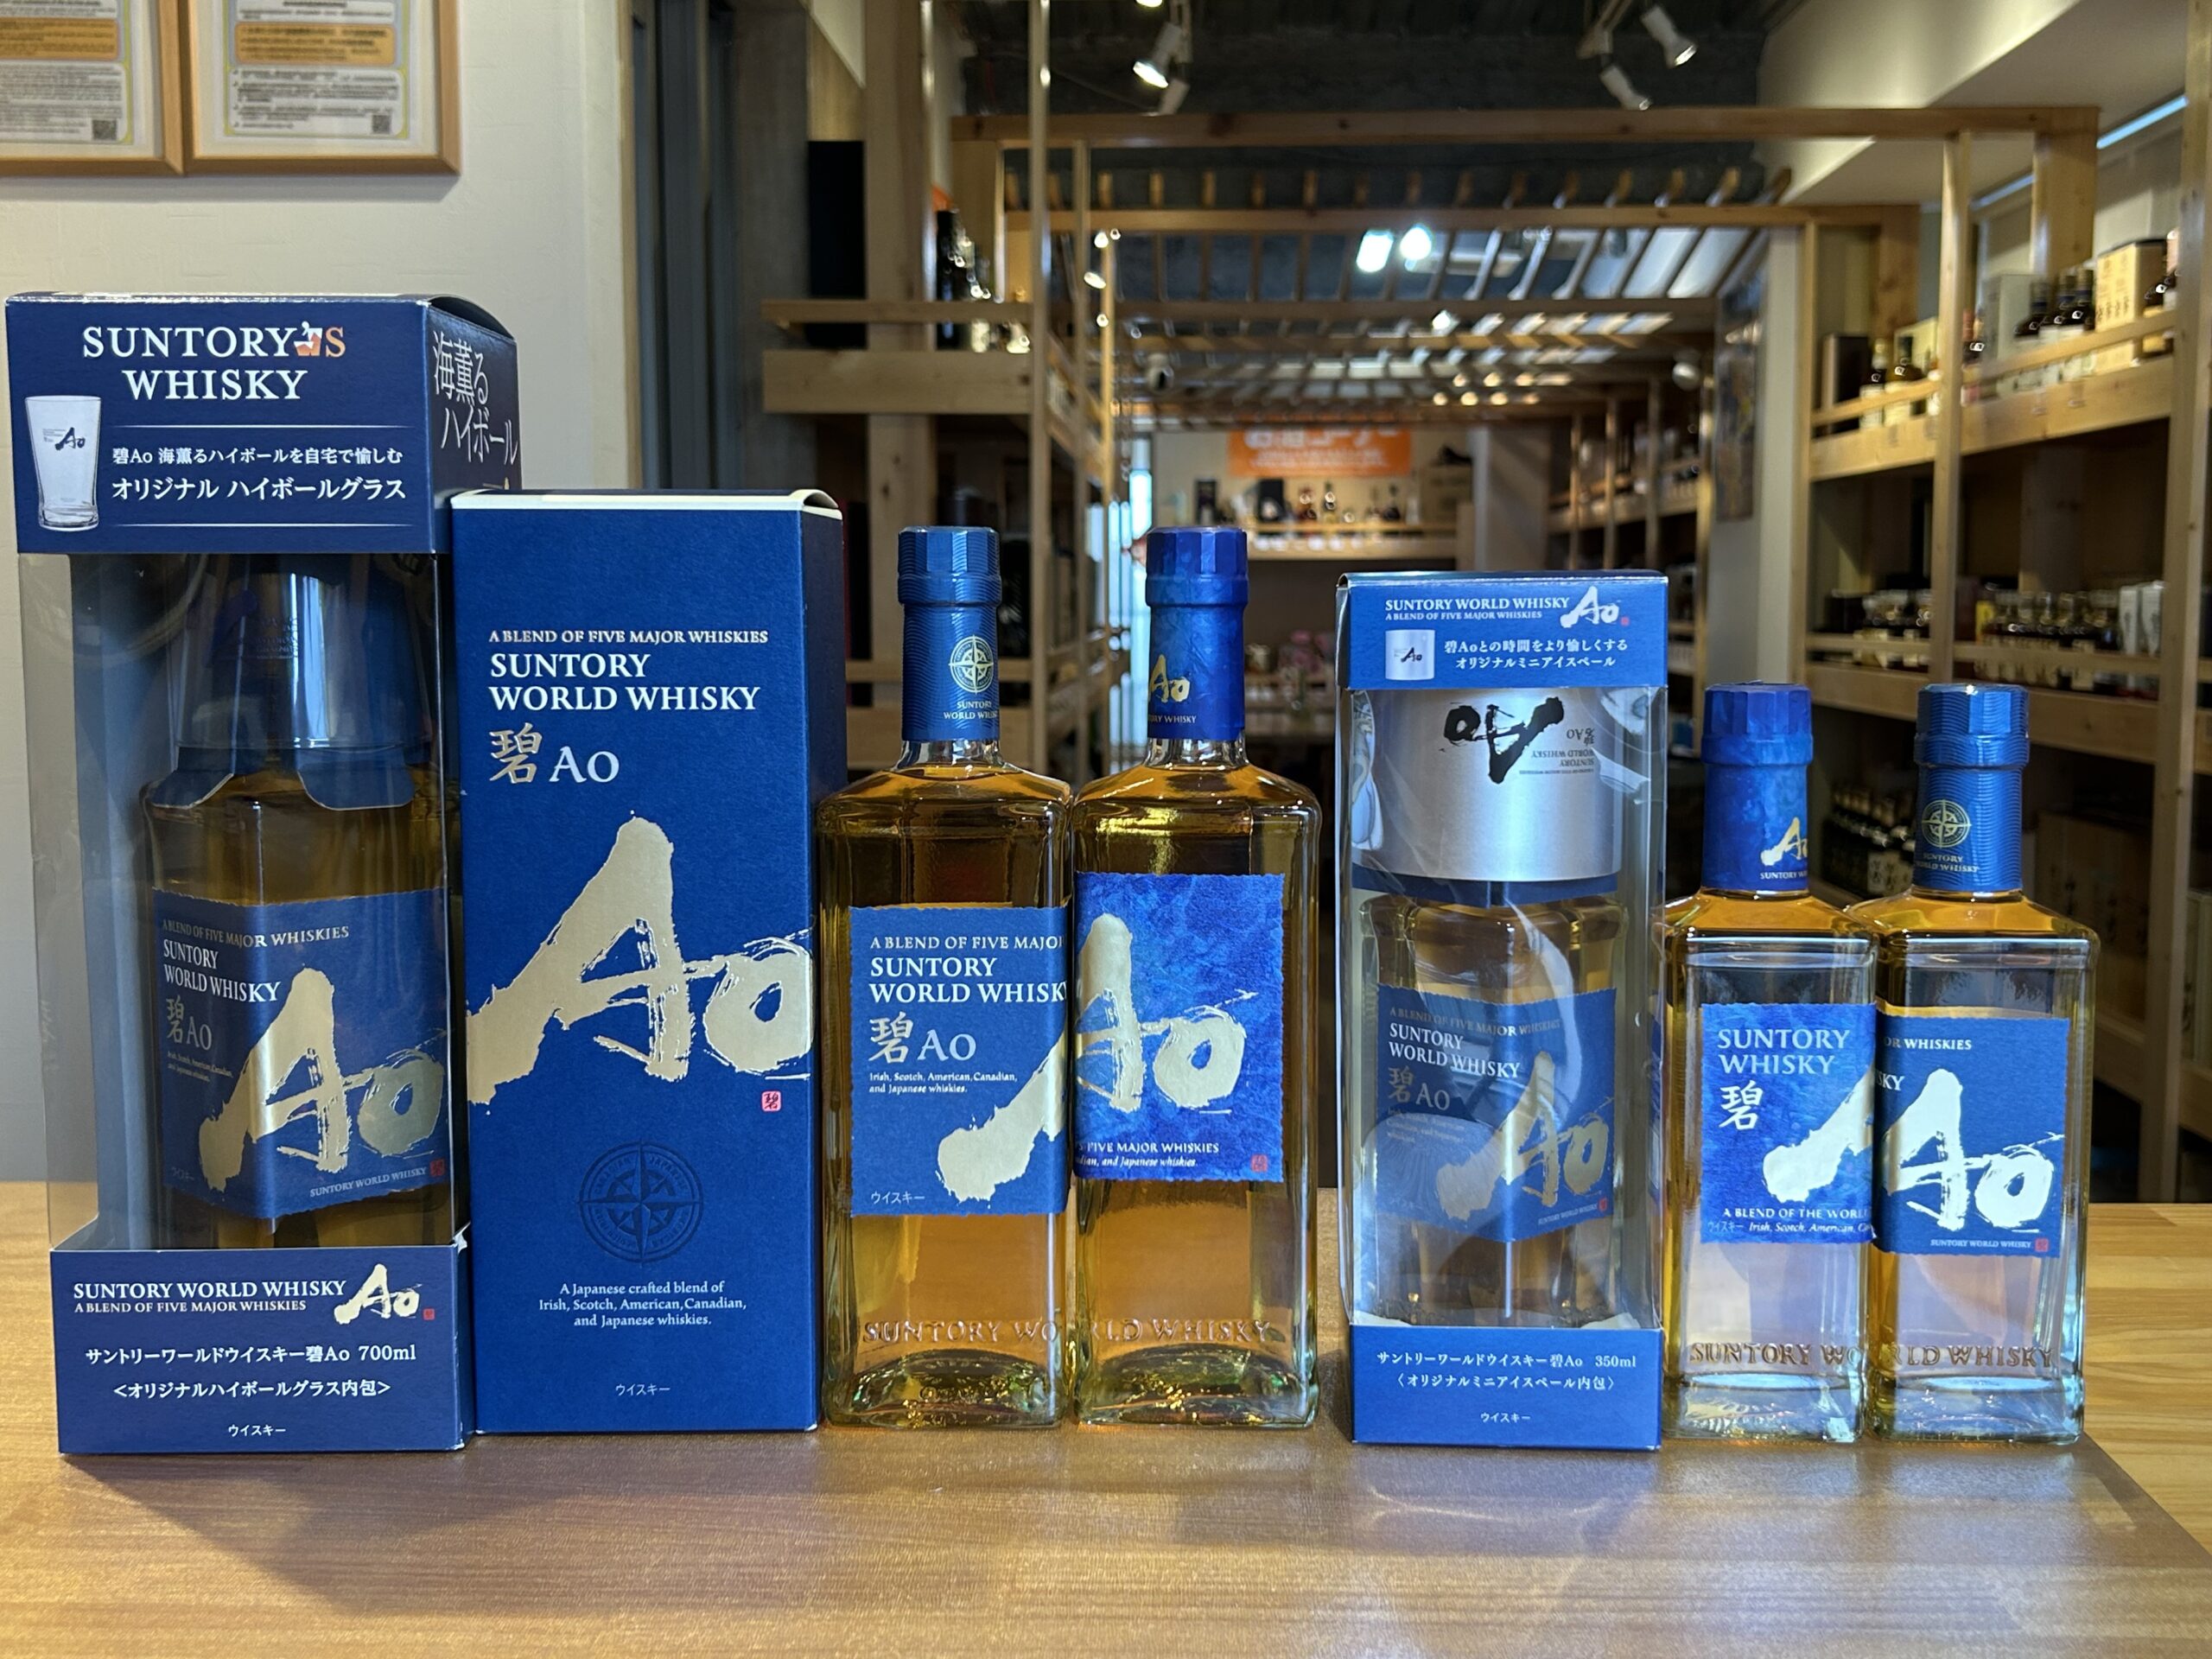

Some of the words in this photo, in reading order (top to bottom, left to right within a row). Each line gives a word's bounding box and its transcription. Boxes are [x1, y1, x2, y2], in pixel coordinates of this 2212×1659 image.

[433, 331, 488, 406] 海薫る
[122, 369, 308, 400] WHISKY
[441, 404, 518, 465] ハイボール
[112, 477, 219, 500] オリジナル
[227, 476, 405, 500] ハイボールグラス
[1385, 600, 1452, 611] SUNTORY
[1454, 599, 1510, 610] WORLD
[1512, 597, 1570, 609] WHISKY
[1393, 612, 1424, 620] BLEND
[1427, 612, 1440, 620] OF
[1441, 612, 1462, 620] FIVE
[1464, 612, 1496, 621] MAJOR
[1497, 611, 1542, 620] WHISKIES
[489, 631, 500, 643] A
[503, 630, 556, 643] BLEND
[562, 630, 584, 643] OF
[588, 630, 625, 643] FIVE
[629, 630, 685, 645] MAJOR
[689, 630, 768, 643] WHISKIES
[490, 653, 651, 677] SUNTORY
[488, 686, 618, 711] WORLD
[626, 686, 760, 711] WHISKY
[944, 711, 975, 720] WORLD
[489, 721, 543, 784] 碧
[194, 925, 205, 938] OF
[206, 927, 225, 942] FIVE
[226, 931, 268, 949] MAJOR
[271, 925, 349, 946] WHISKIES
[870, 937, 880, 949] A
[885, 937, 940, 949] BLEND
[944, 937, 967, 949] OF
[972, 937, 1008, 949] FIVE
[163, 938, 219, 969] SUNTORY
[466, 812, 813, 1107] Ao
[870, 957, 997, 977] SUNTORY
[164, 964, 207, 993] WORLD
[210, 976, 282, 1002] WHISKY
[868, 983, 971, 1003] WORLD
[868, 1011, 913, 1064] 碧
[1389, 1022, 1464, 1051] SUNTORY
[1717, 1028, 1851, 1049] SUNTORY
[1904, 1039, 1973, 1050] WHISKIES
[1389, 1041, 1447, 1066] WORLD
[1451, 1054, 1521, 1078] WHISKY
[1719, 1054, 1835, 1075] WHISKY
[199, 967, 447, 1192] Ao
[1718, 1079, 1764, 1131] 碧
[1116, 1142, 1158, 1154] MAJOR
[1161, 1142, 1219, 1154] WHISKIES
[310, 1180, 354, 1198] SUNTORY
[355, 1174, 390, 1188] WORLD
[391, 1167, 427, 1180] WHISKY
[870, 1191, 925, 1205] ウイスキー
[1723, 1209, 1731, 1217] A
[1735, 1208, 1775, 1217] BLEND
[1778, 1208, 1795, 1217] OF
[1799, 1208, 1821, 1218] THE
[73, 1281, 174, 1299] SUNTORY
[176, 1281, 257, 1298] WORLD
[262, 1281, 346, 1296] WHISKY
[333, 1263, 423, 1325] Ao
[560, 1283, 569, 1294] A
[572, 1283, 626, 1297] Japanese
[628, 1281, 671, 1294] crafted
[674, 1281, 708, 1294] blend
[710, 1281, 725, 1293] of
[74, 1302, 85, 1313] A
[86, 1302, 131, 1313] BLEND
[135, 1302, 154, 1313] OF
[157, 1301, 188, 1313] FIVE
[191, 1300, 238, 1314] MAJOR
[239, 1300, 307, 1312] WHISKIES
[539, 1299, 570, 1312] Irish,
[573, 1298, 618, 1312] Scotch,
[620, 1298, 683, 1311] American,
[684, 1297, 747, 1310] Canadian,
[574, 1315, 597, 1326] and
[601, 1315, 654, 1328] Japanese
[657, 1313, 712, 1326] whiskies.
[1152, 1318, 1270, 1343] WHISKY
[863, 1319, 1001, 1344] SUNTORY
[86, 1346, 349, 1365] サントリーワールドウイスキー碧Ao
[359, 1344, 416, 1361] 700ml
[1594, 1354, 1636, 1368] 350ml
[1689, 1342, 1811, 1365] SUNTORY
[1948, 1345, 2053, 1368] WHISKY
[615, 1383, 671, 1396] ウイスキー
[1480, 1413, 1531, 1423] ウイスキー
[227, 1424, 286, 1438] ウイスキー
